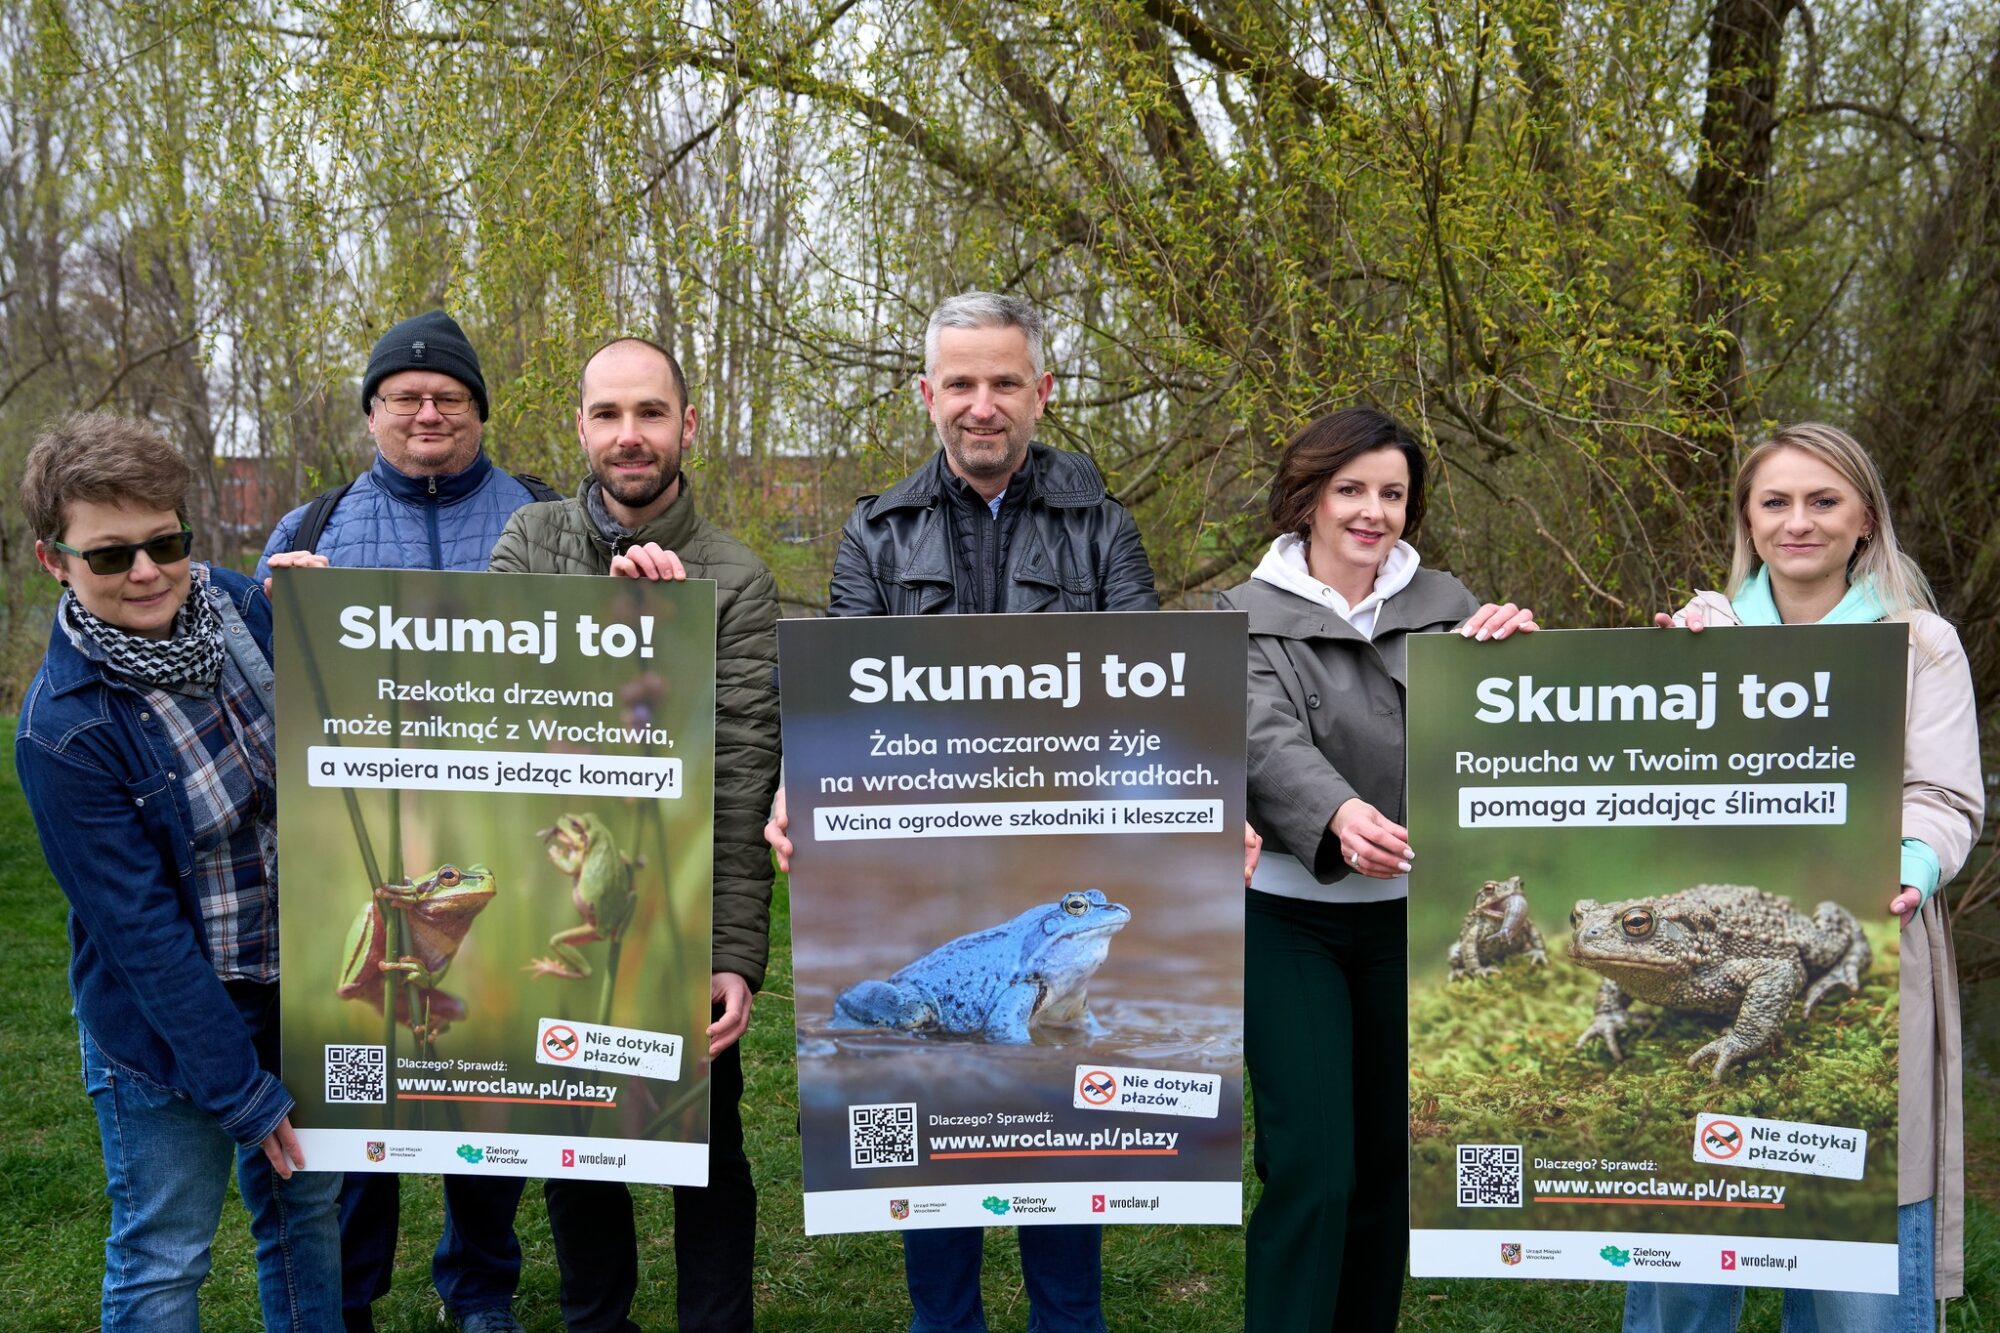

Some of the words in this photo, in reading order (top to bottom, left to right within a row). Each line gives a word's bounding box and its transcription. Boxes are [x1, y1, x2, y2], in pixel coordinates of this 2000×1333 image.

[338, 605, 558, 664] Skumaj
[576, 614, 655, 659] to!
[848, 651, 1081, 708] Skumaj
[1101, 652, 1186, 698] to!
[377, 678, 495, 704] Rzekotka
[503, 682, 614, 708] drzewna
[1474, 671, 1717, 730] Skumaj
[1738, 671, 1831, 720] to!
[323, 713, 392, 736] może
[400, 715, 498, 744] zniknąć
[506, 723, 519, 740] z
[528, 718, 675, 748] Wrocławia,
[869, 728, 938, 757] Żaba
[946, 731, 1099, 755] moczarowa
[1109, 728, 1160, 757] żyje
[1455, 750, 1578, 779] Ropucha
[1587, 753, 1615, 772] w
[1623, 747, 1718, 772] Twoim
[1727, 745, 1856, 777] ogrodzie
[320, 758, 336, 776] a
[344, 757, 438, 785] wspiera
[447, 763, 489, 781] nas
[495, 760, 571, 788] jedząc
[579, 763, 675, 792] komary!
[820, 774, 853, 793] na
[862, 766, 1045, 792] wrocławskich
[1054, 763, 1219, 788] mokradłach.
[1470, 797, 1586, 823] pomaga
[1596, 792, 1715, 822] zjadając
[1725, 790, 1835, 815] ślimaki!
[825, 812, 892, 832] Wcina
[898, 809, 1002, 834] ogrodowe
[1009, 808, 1105, 828] szkodniki
[1111, 808, 1117, 825] i
[1124, 806, 1214, 825] kleszcze!
[585, 1031, 611, 1047] Nie
[616, 1034, 676, 1056] dotykaj
[397, 1057, 454, 1071] Dlaczego?
[457, 1058, 508, 1074] Sprawdź:
[583, 1048, 641, 1068] płazów
[397, 1076, 617, 1102] www.wroclaw.pl/plazy
[1122, 1075, 1149, 1089] Nie
[1154, 1077, 1214, 1094] dotykaj
[1121, 1091, 1179, 1107] płazów
[929, 1112, 994, 1127] Dlaczego?
[996, 1111, 1054, 1126] Sprawdź:
[929, 1128, 1179, 1150] www.wroclaw.pl/plazy
[1750, 1126, 1781, 1143] Nie
[1787, 1128, 1858, 1152] dotykaj
[486, 1146, 520, 1157] Zielony
[486, 1155, 528, 1166] Wrocław
[578, 1151, 626, 1168] wroclaw.pl
[1748, 1145, 1816, 1166] płazów
[1534, 1157, 1597, 1172] Dlaczego?
[1600, 1158, 1658, 1173] Sprawdź:
[1534, 1176, 1785, 1204] www.wroclaw.pl/plazy
[1012, 1196, 1048, 1206] Zielony
[1012, 1204, 1057, 1214] Wrocław
[1109, 1196, 1160, 1211] wroclaw.pl
[1633, 1248, 1671, 1259] Zielony
[1633, 1257, 1682, 1268] Wrocław
[1740, 1253, 1798, 1271] wroclaw.pl
